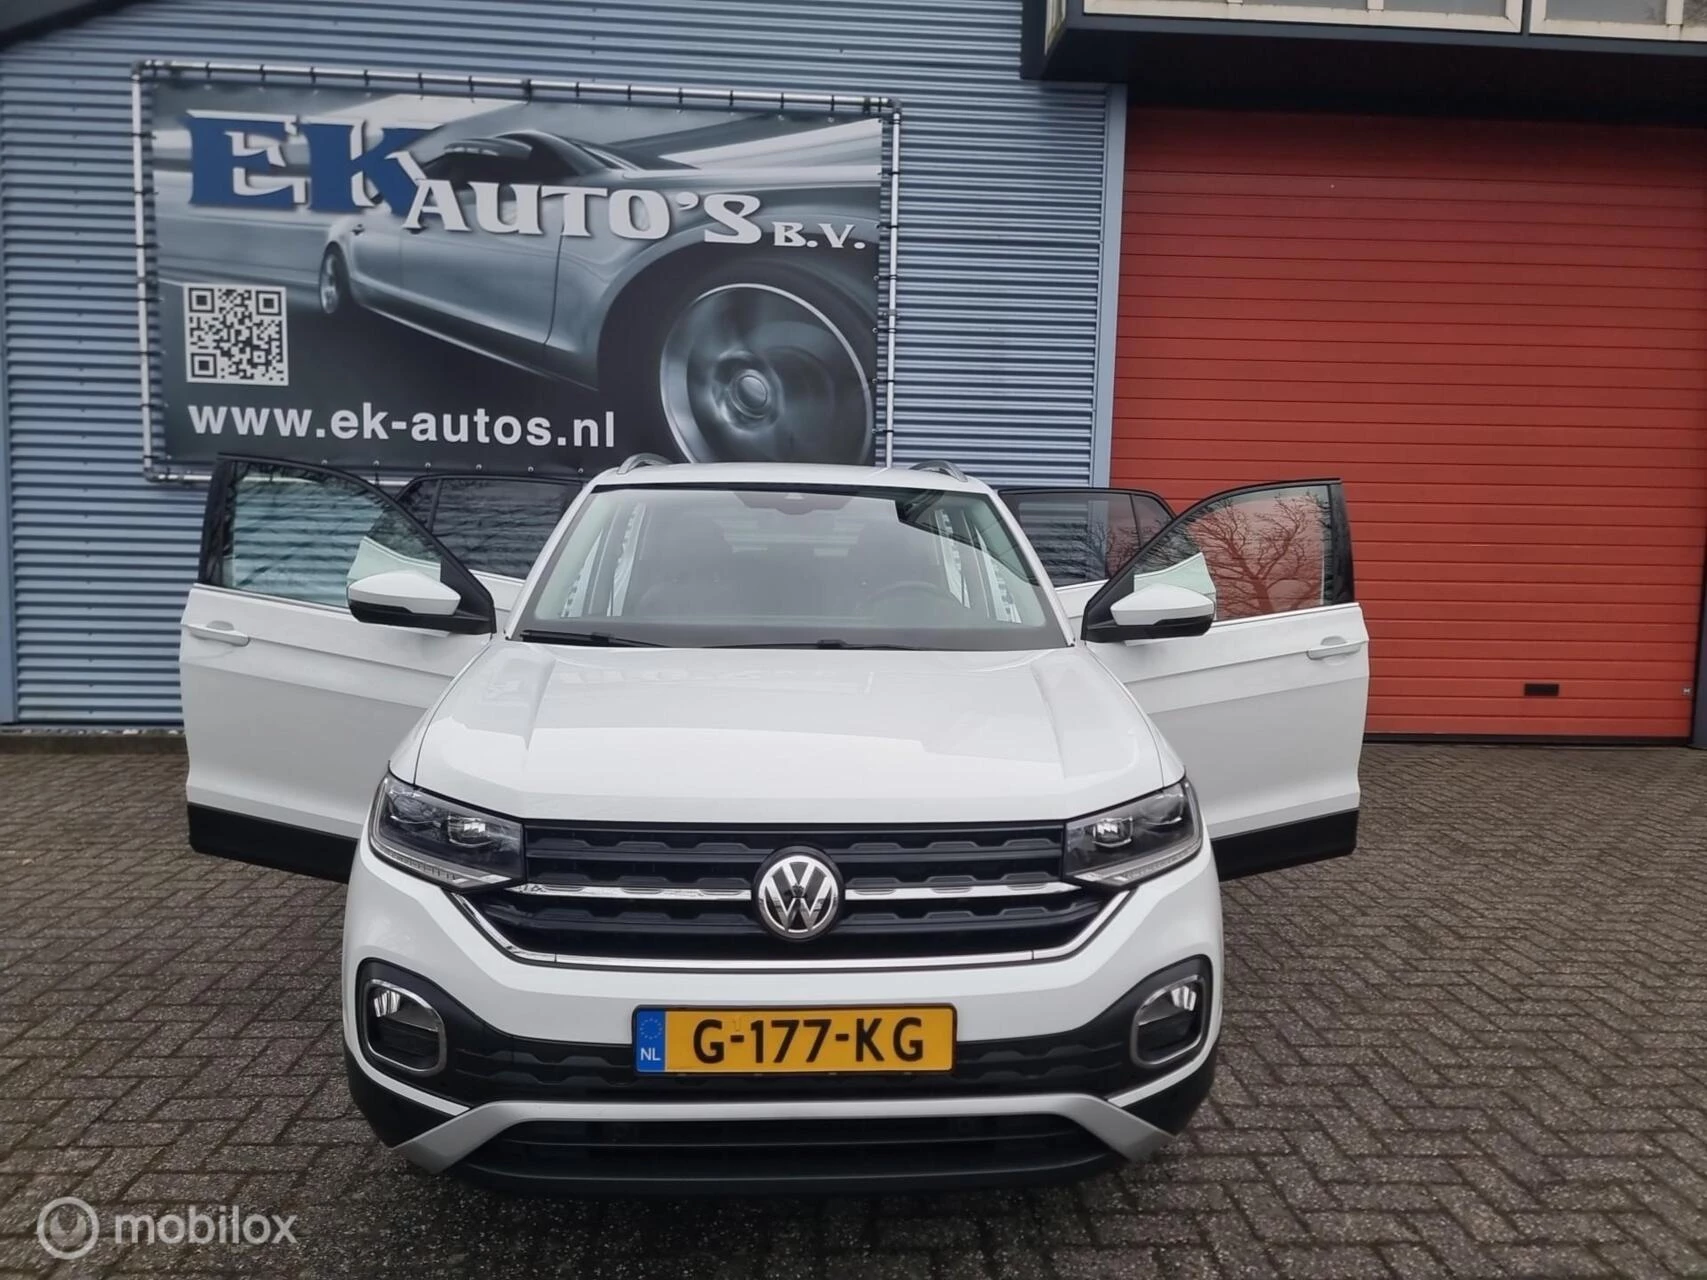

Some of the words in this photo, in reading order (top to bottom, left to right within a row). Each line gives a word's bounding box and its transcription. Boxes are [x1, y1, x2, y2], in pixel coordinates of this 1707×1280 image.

[186, 109, 440, 216] EK
[402, 179, 762, 245] AUTO'S
[772, 221, 866, 250] B.V.
[188, 402, 615, 447] www.ek-autos.nl
[640, 1047, 661, 1061] NL
[693, 1017, 924, 1064] G-177-KG
